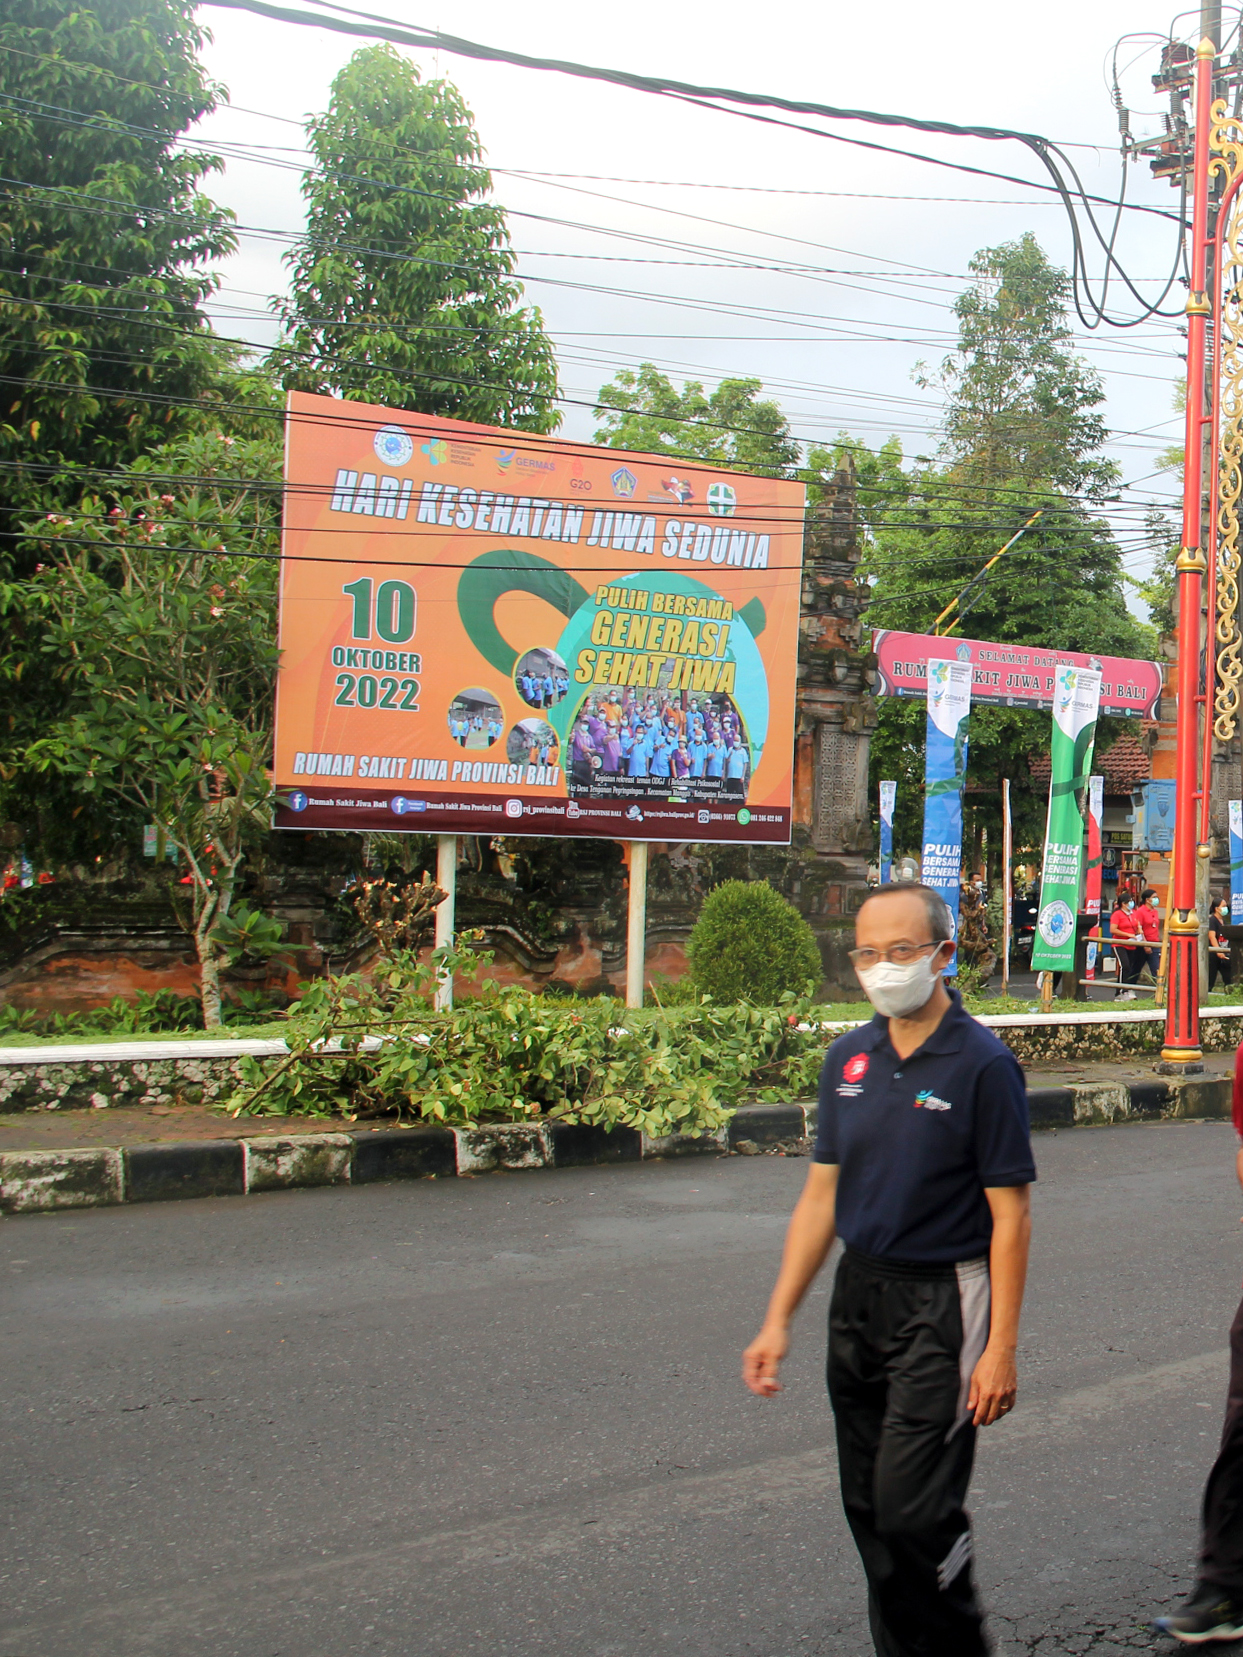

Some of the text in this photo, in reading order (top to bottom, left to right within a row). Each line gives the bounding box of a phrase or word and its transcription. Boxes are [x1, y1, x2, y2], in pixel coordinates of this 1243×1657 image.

[515, 457, 556, 472] GERMAS
[570, 478, 592, 491] G20
[330, 468, 770, 569] HARI KESEHATAN JIWA SEDUNIA
[343, 577, 417, 644] 10
[595, 585, 734, 621] PULIH BERSAMA
[590, 609, 731, 658] GENERASI
[332, 645, 422, 674] OKTOBER
[574, 648, 736, 694] SEHAT JIWA
[979, 650, 1075, 667] SELAMAT DATANG
[335, 672, 421, 712] 2022
[893, 661, 928, 679] RUM
[1006, 674, 1041, 690] JIWA
[1117, 685, 1147, 700] BALI
[292, 751, 560, 786] RUMAH SAKIT JIWA PROVINSI BALI
[308, 798, 335, 807] Rumah
[336, 799, 355, 807] Sakit
[355, 799, 372, 808] Jiwa
[373, 800, 388, 809] Bali
[426, 801, 444, 810] Rumah
[445, 802, 459, 811] Sakit
[459, 803, 471, 811] Jiwa
[471, 803, 491, 812] Provinsi
[492, 804, 503, 812] Bali
[923, 843, 962, 857] PULIH
[921, 866, 960, 877] GENERAS
[921, 876, 948, 888] SEHAT
